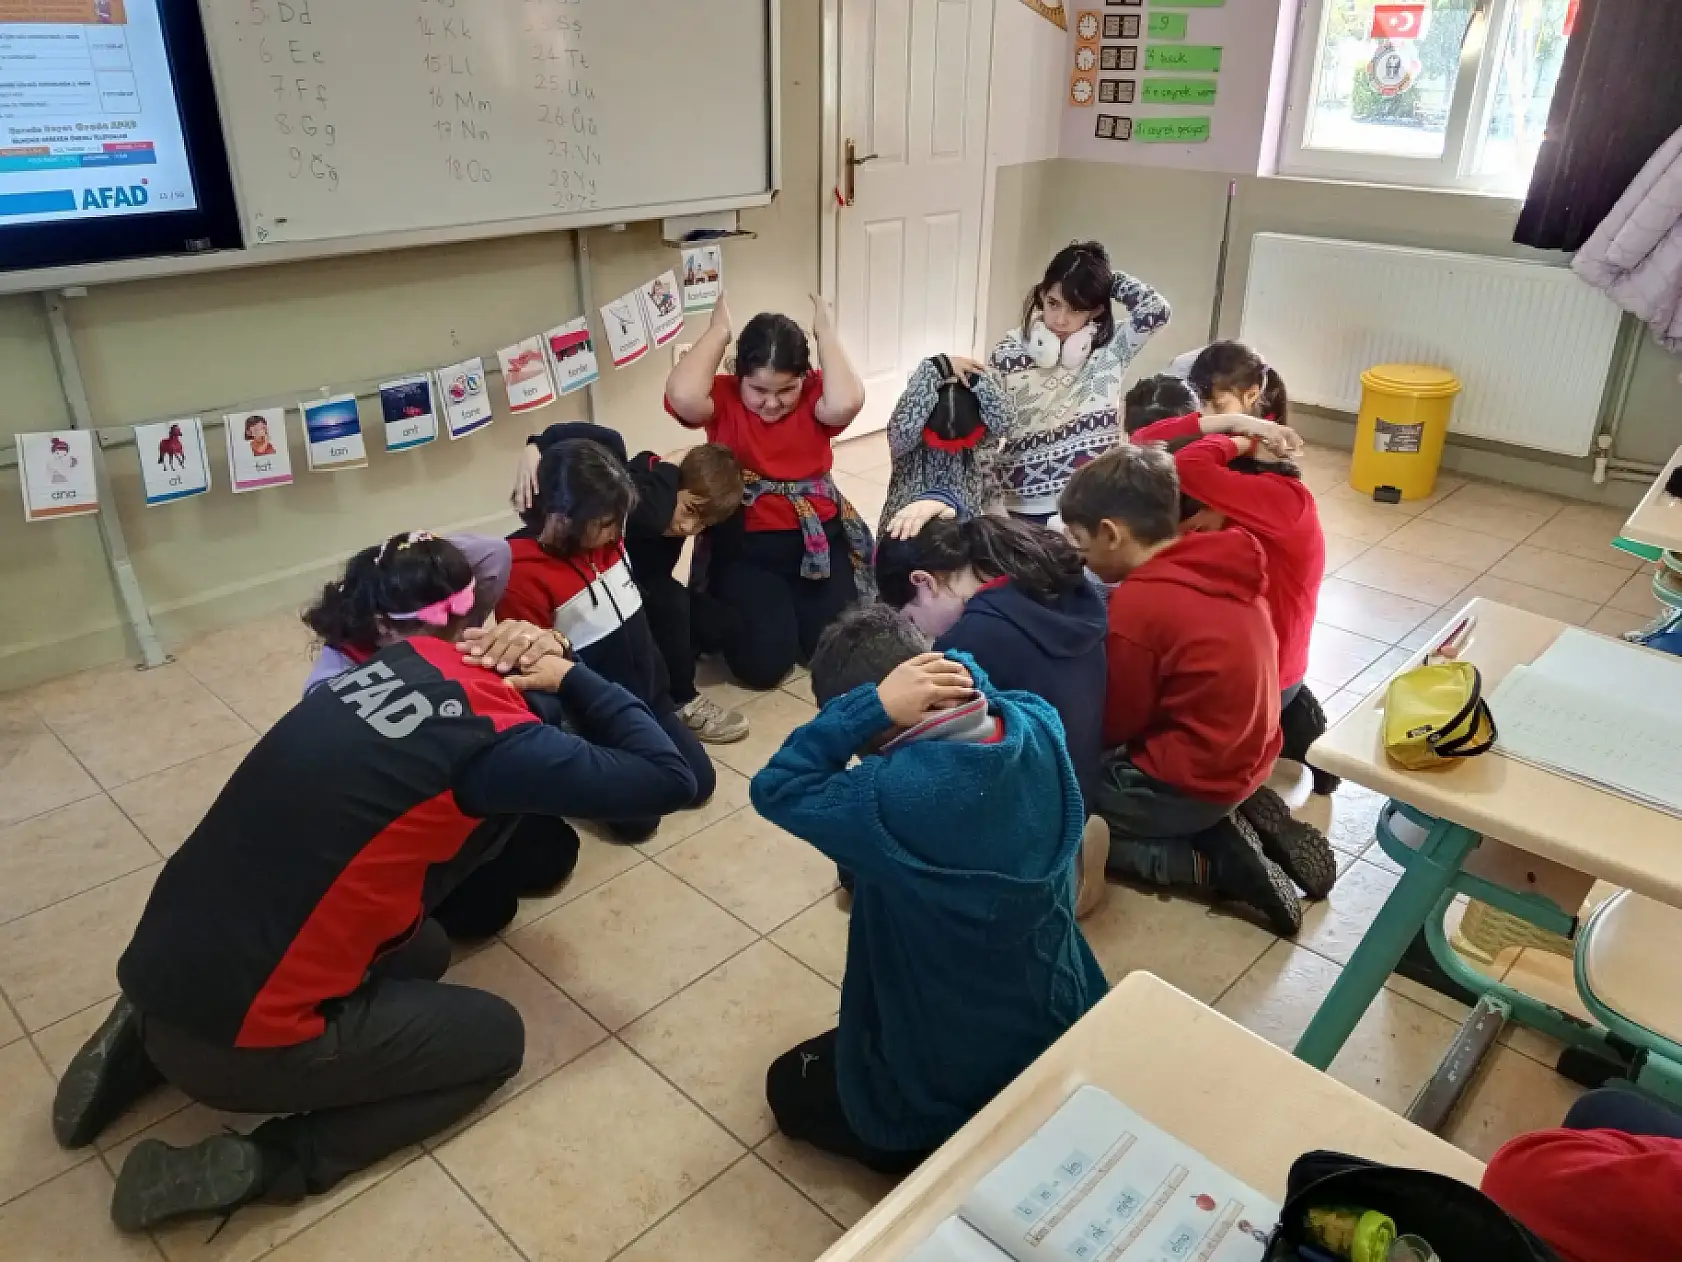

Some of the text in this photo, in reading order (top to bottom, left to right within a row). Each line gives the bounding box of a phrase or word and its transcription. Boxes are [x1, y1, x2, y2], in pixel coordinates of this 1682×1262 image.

[83, 185, 148, 211] AFAD
[329, 446, 349, 458] tan
[168, 474, 183, 487] at
